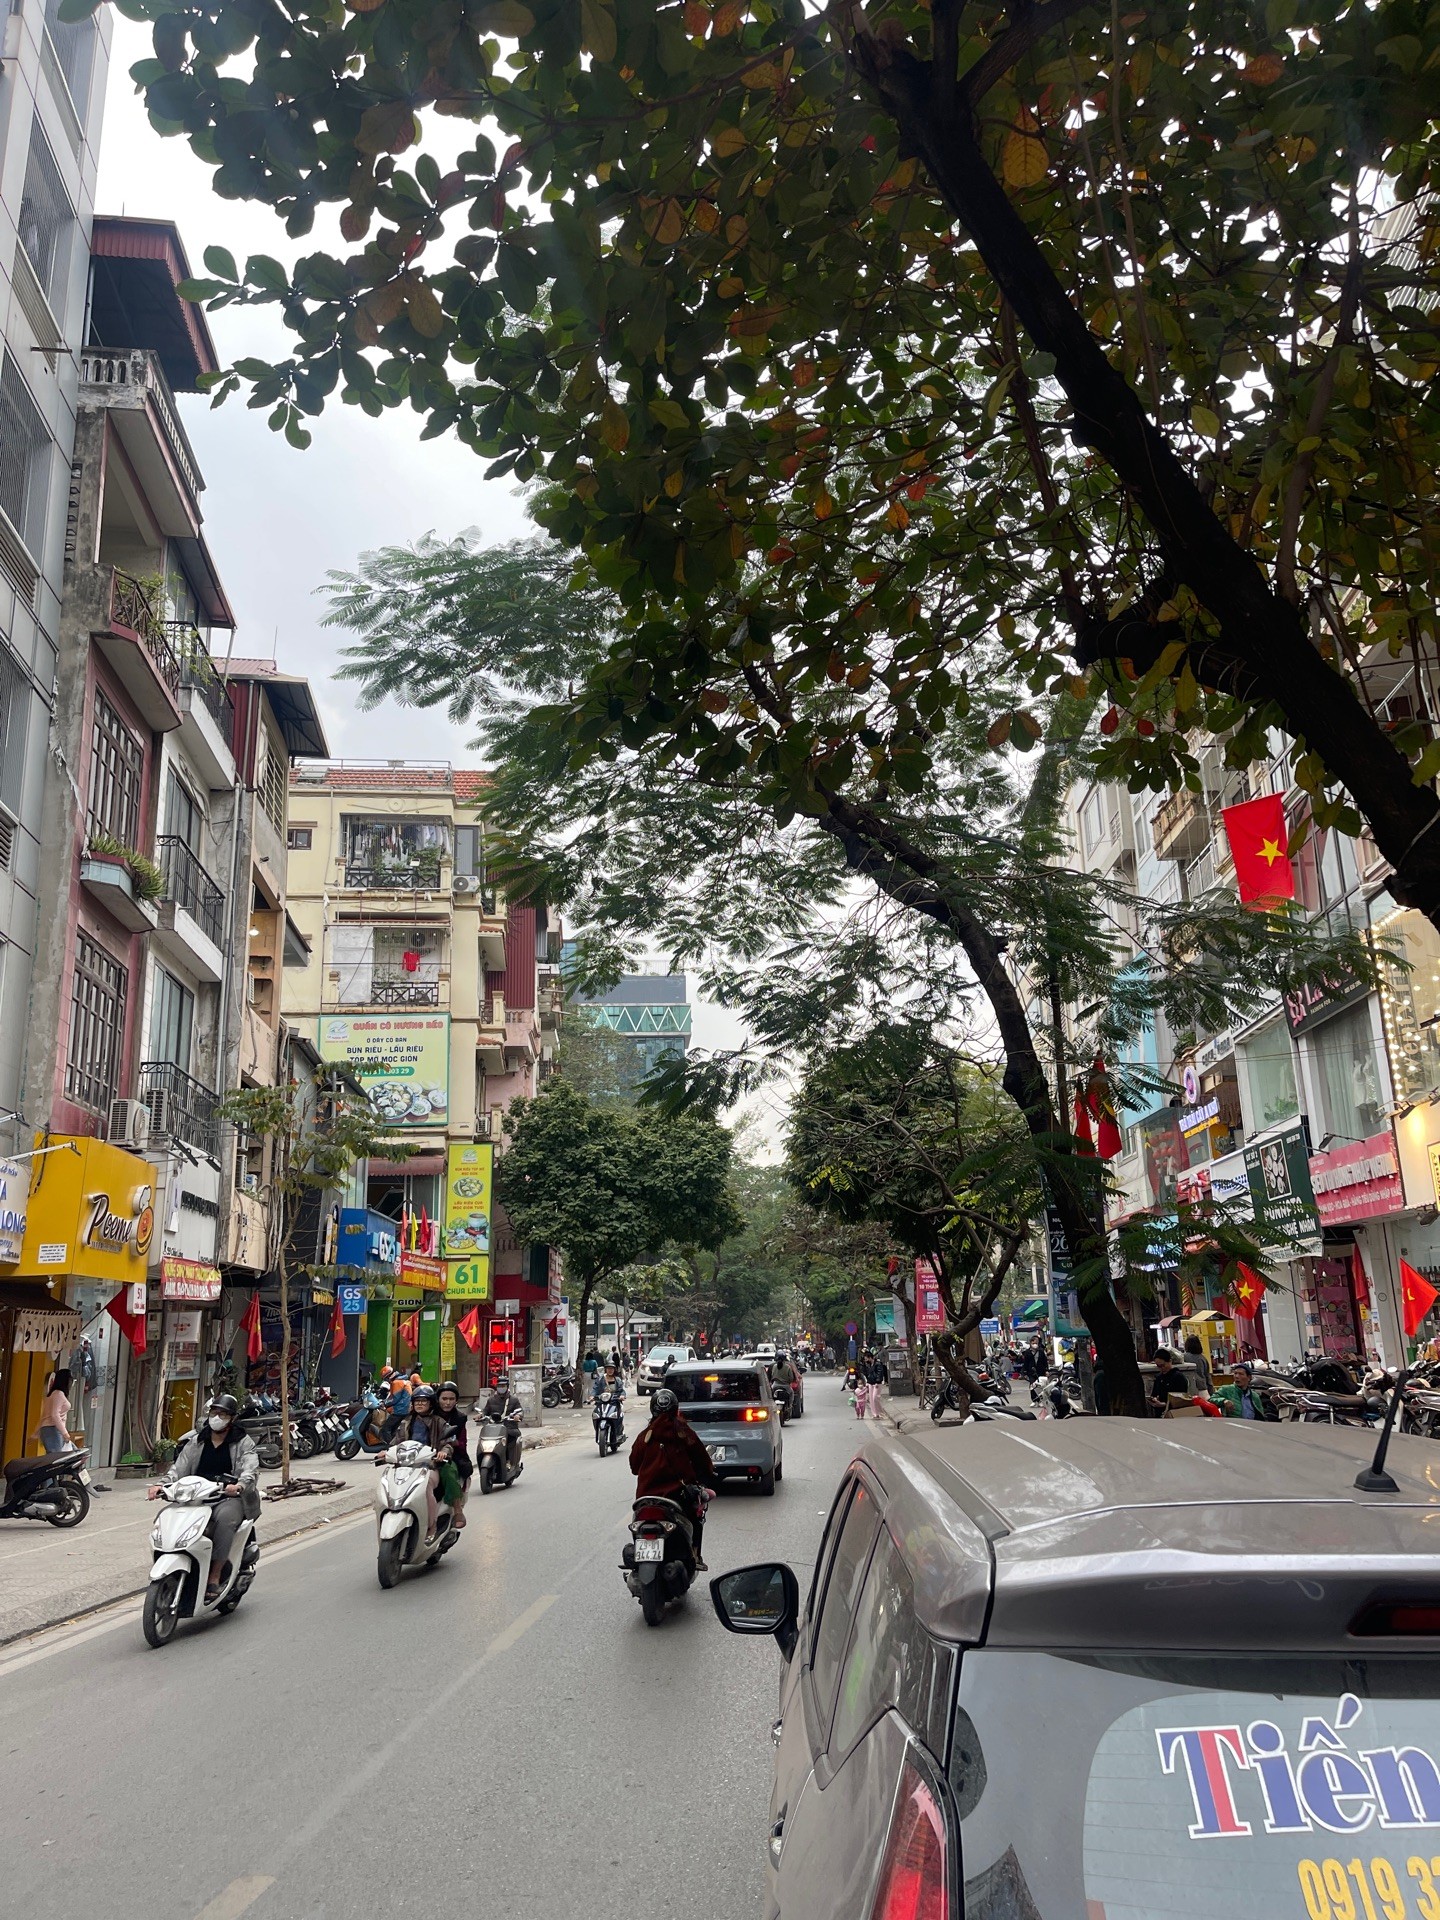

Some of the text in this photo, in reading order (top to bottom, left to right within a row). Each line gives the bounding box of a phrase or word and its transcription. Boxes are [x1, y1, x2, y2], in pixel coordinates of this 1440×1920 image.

[353, 1020, 378, 1031] QUÁN
[380, 1021, 391, 1030] CÔ
[1, 1210, 27, 1234] LONG
[84, 1192, 132, 1246] Poeme
[455, 1264, 478, 1284] 61
[137, 1288, 142, 1299] 51
[343, 1288, 361, 1300] GS
[343, 1300, 360, 1311] 25
[1154, 1693, 1440, 1839] Tiến
[1297, 1856, 1440, 1920] 0919 3
